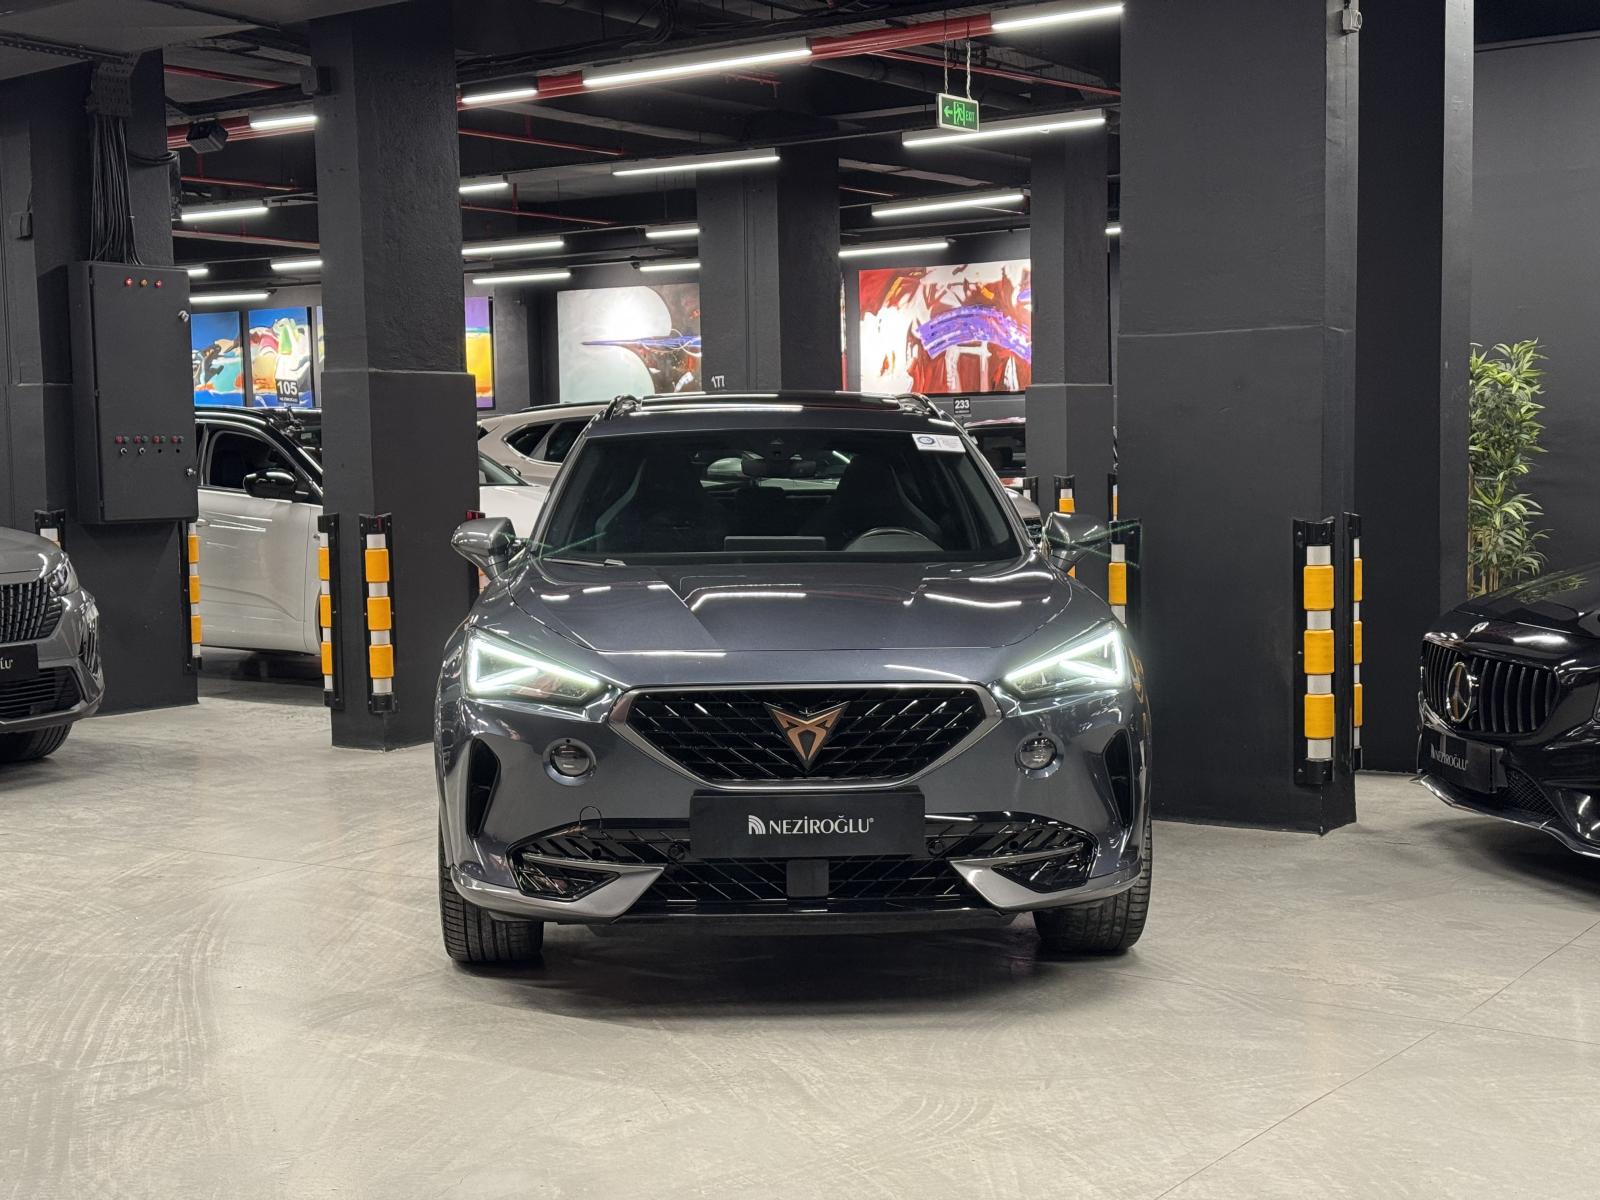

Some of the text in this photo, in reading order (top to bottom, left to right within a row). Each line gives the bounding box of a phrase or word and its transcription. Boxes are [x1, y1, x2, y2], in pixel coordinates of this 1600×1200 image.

[966, 110, 975, 122] EXIT
[277, 380, 298, 396] 105
[954, 399, 970, 410] 233
